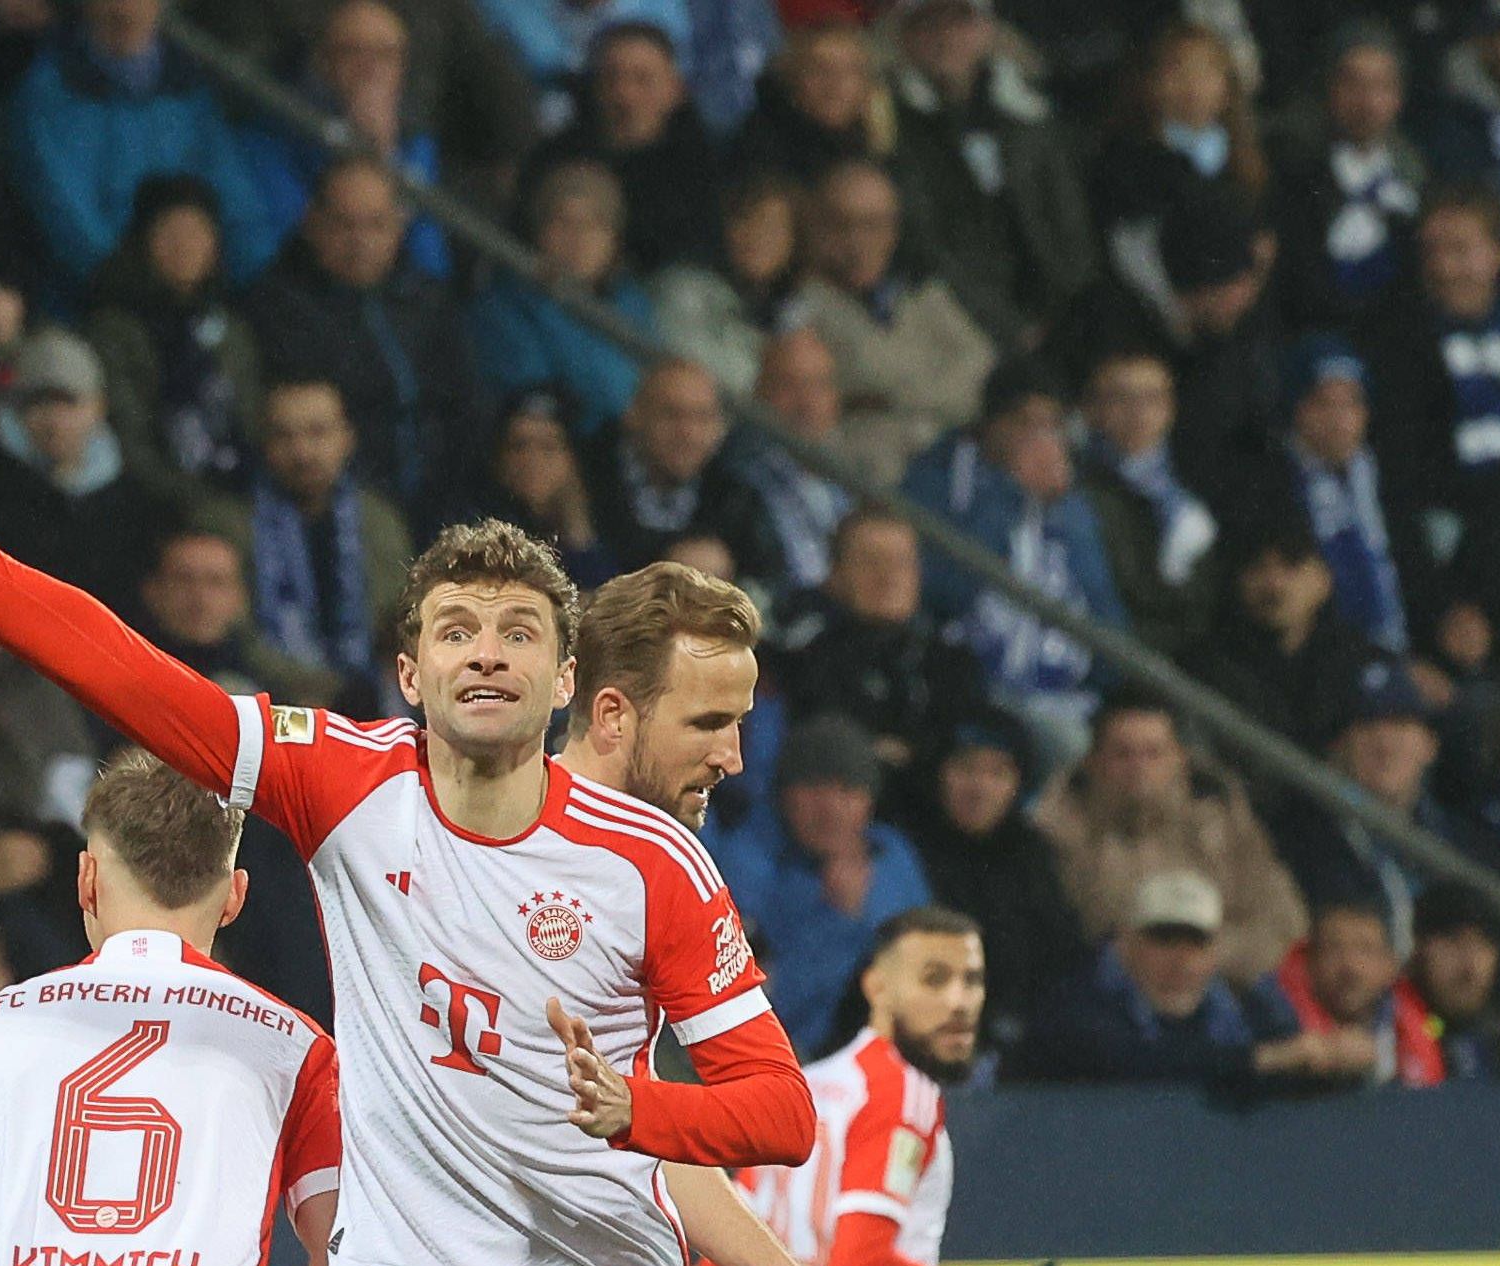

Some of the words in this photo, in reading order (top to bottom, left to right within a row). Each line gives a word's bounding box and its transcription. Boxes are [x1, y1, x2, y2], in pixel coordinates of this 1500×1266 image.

[543, 908, 579, 931] BAYERN
[38, 982, 151, 1003] BAYERN
[163, 987, 296, 1036] MÜNCHEN
[45, 1020, 183, 1234] 6
